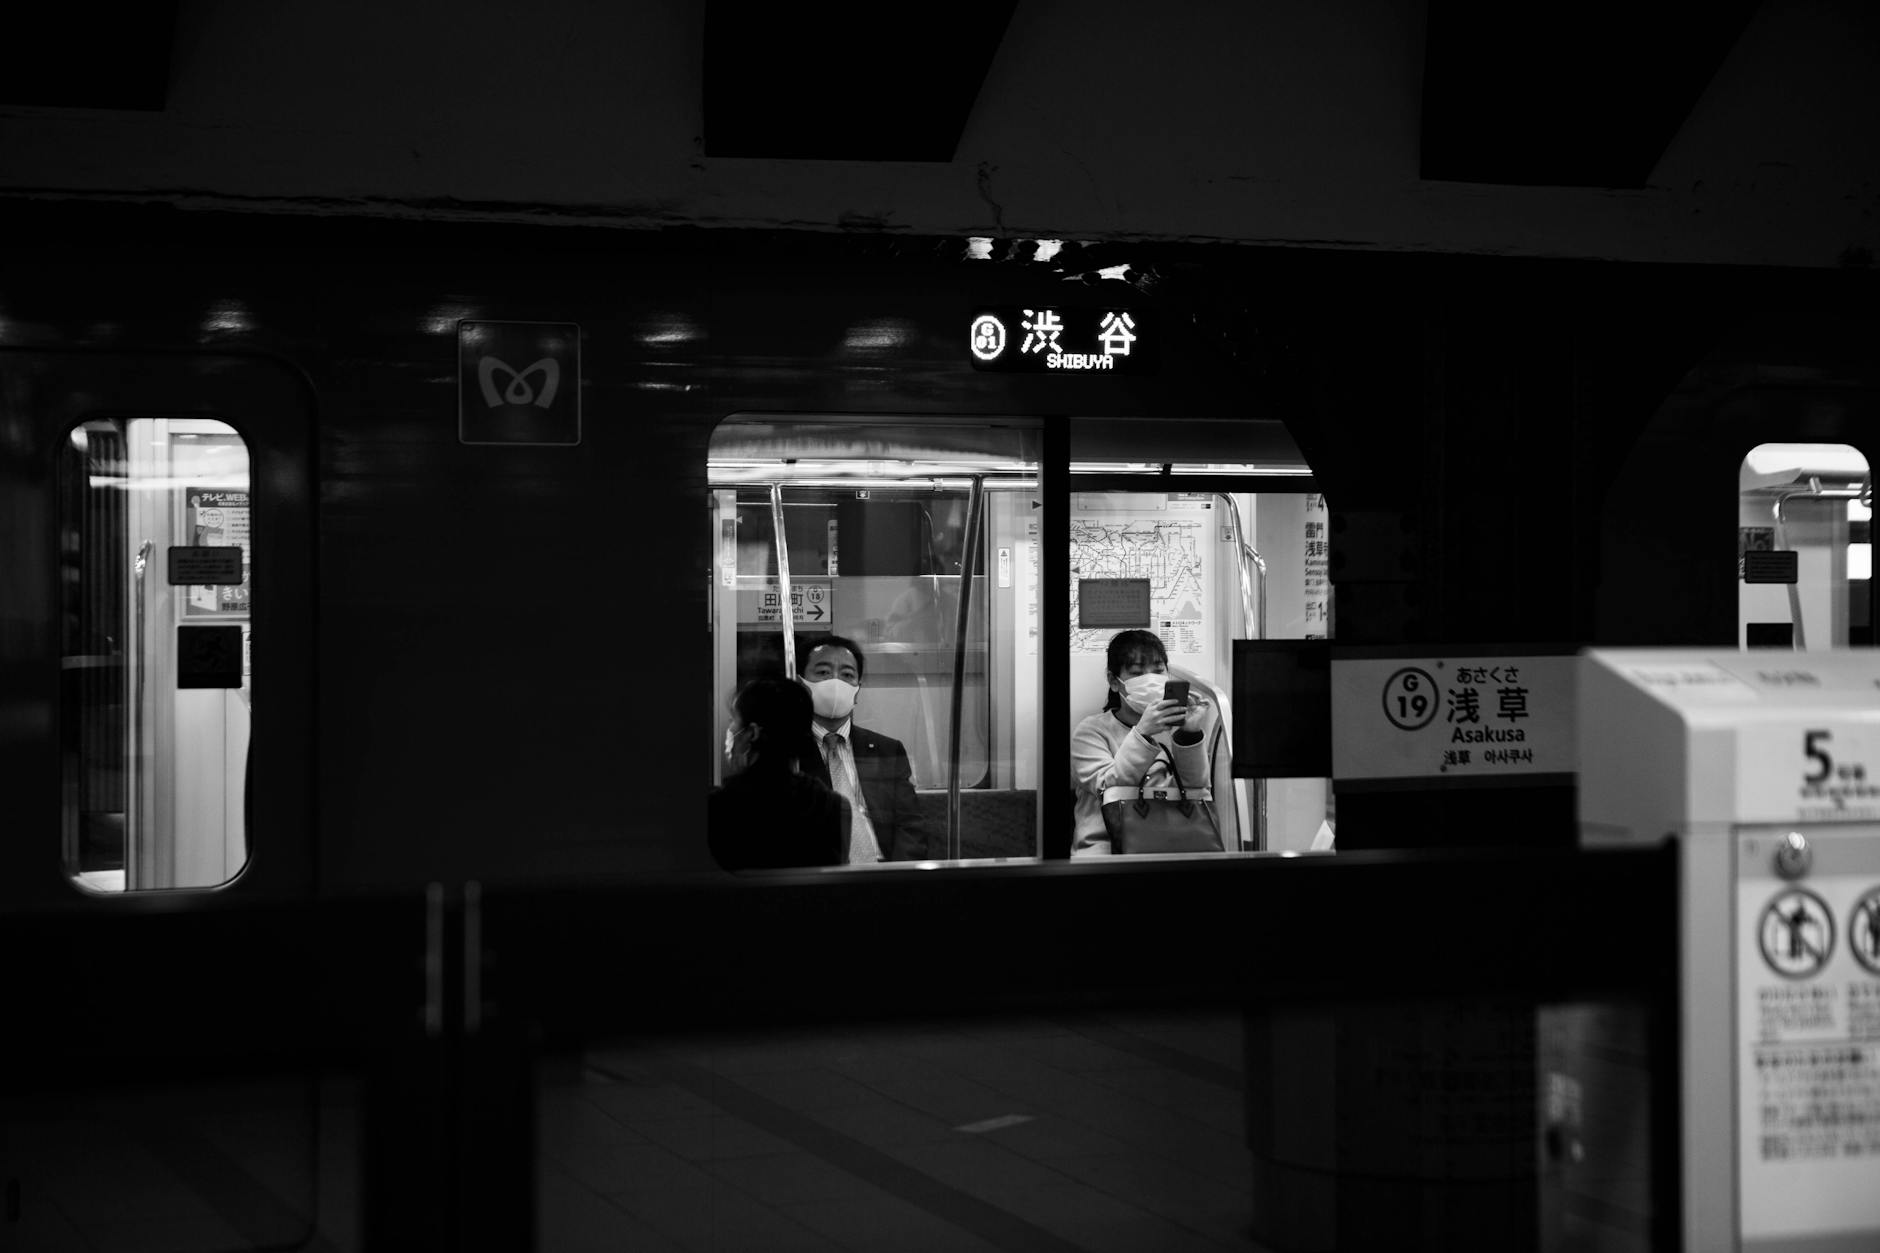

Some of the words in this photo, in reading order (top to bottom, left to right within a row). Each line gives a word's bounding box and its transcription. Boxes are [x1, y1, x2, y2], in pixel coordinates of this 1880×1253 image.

[1020, 309, 1137, 356] 渋谷
[975, 335, 998, 350] 01
[1046, 353, 1114, 369] SHIBUYA
[764, 593, 804, 607] 田町
[1403, 674, 1418, 692] G
[1456, 666, 1519, 684] あさくさ
[1397, 694, 1428, 718] 19
[1447, 687, 1529, 723] 浅草
[1451, 724, 1525, 743] Asakusa
[1484, 748, 1533, 764] 아사쿠사
[1803, 728, 1834, 784] 5
